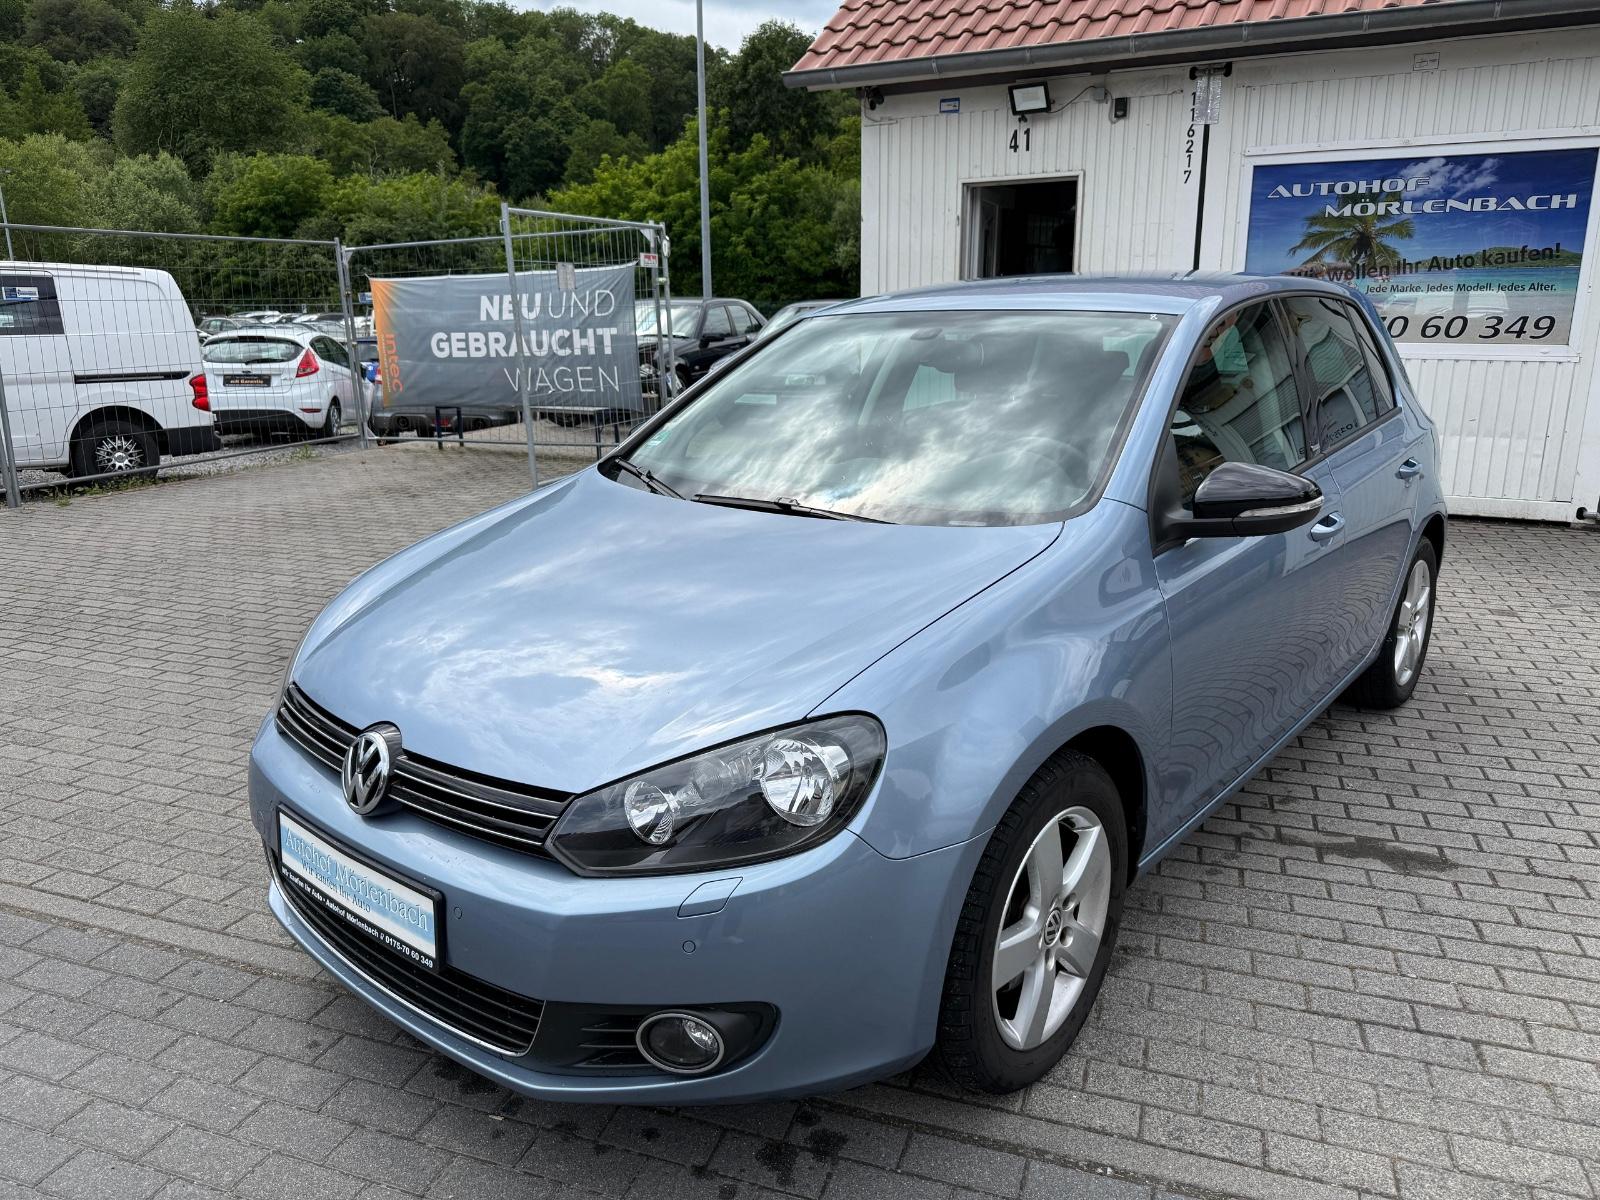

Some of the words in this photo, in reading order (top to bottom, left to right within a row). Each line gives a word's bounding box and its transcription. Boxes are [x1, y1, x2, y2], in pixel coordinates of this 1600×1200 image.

[1009, 127, 1031, 153] 41
[1267, 176, 1431, 199] AUTOHOF
[1324, 194, 1577, 219] MÖRLENBACH
[1327, 263, 1390, 282] wollen
[1395, 258, 1422, 275] Ihr
[1427, 254, 1475, 272] Auto
[1481, 242, 1561, 265] kaufen!
[1366, 284, 1388, 294] Jede
[1389, 284, 1424, 293] Marke.
[1426, 283, 1454, 294] Jedes
[1456, 282, 1495, 292] Modell.
[1496, 282, 1526, 293] Jedes
[1528, 281, 1557, 291] Alter.
[480, 292, 542, 321] NEU
[548, 289, 615, 319] UND
[1381, 315, 1409, 339] 0
[1420, 315, 1469, 339] 60
[1478, 315, 1556, 340] 349
[430, 327, 618, 358] GEBRAUCHT
[503, 366, 620, 393] WAGEN
[286, 828, 332, 876] Autohof
[335, 860, 428, 932] Mörlenbach
[385, 935, 410, 955] 0175-70
[420, 955, 434, 969] 349
